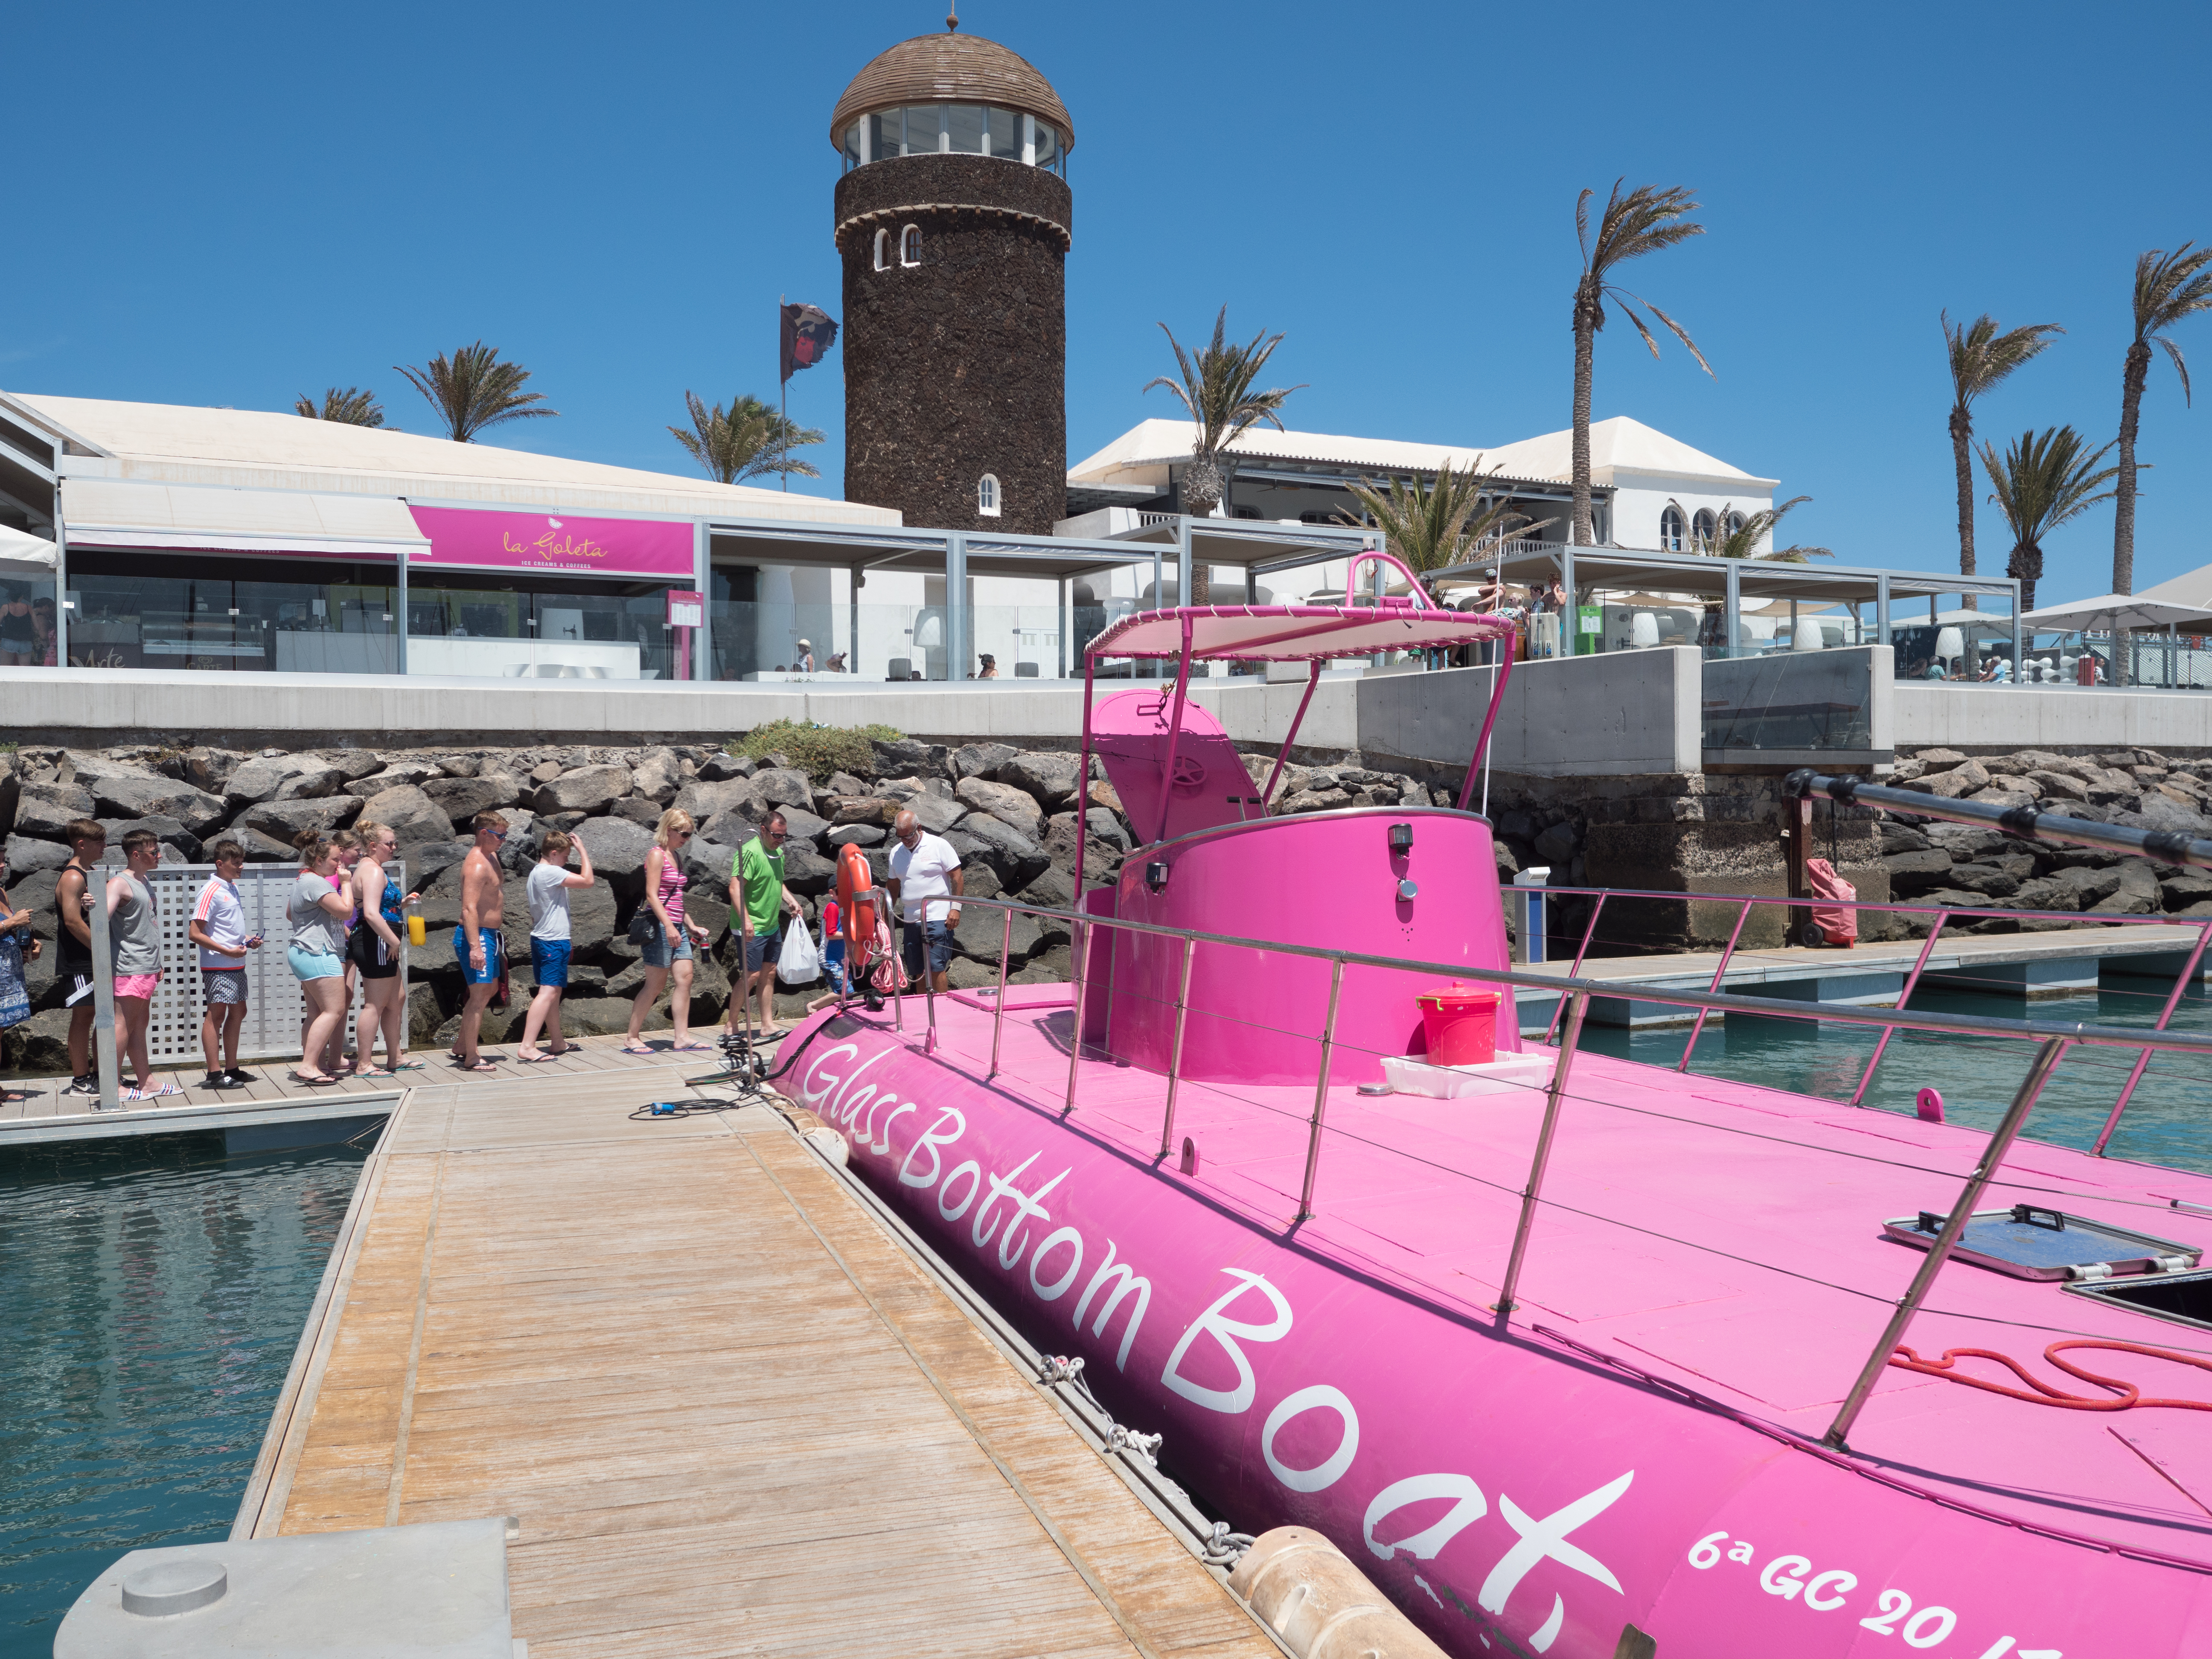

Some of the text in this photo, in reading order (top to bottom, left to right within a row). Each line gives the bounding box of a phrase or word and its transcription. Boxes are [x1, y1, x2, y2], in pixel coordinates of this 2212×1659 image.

[504, 532, 608, 561] la Goleta
[803, 1044, 1635, 1654] Glass Bottom Boat
[1760, 1555, 1858, 1611] GC
[1859, 1589, 1957, 1648] 20
